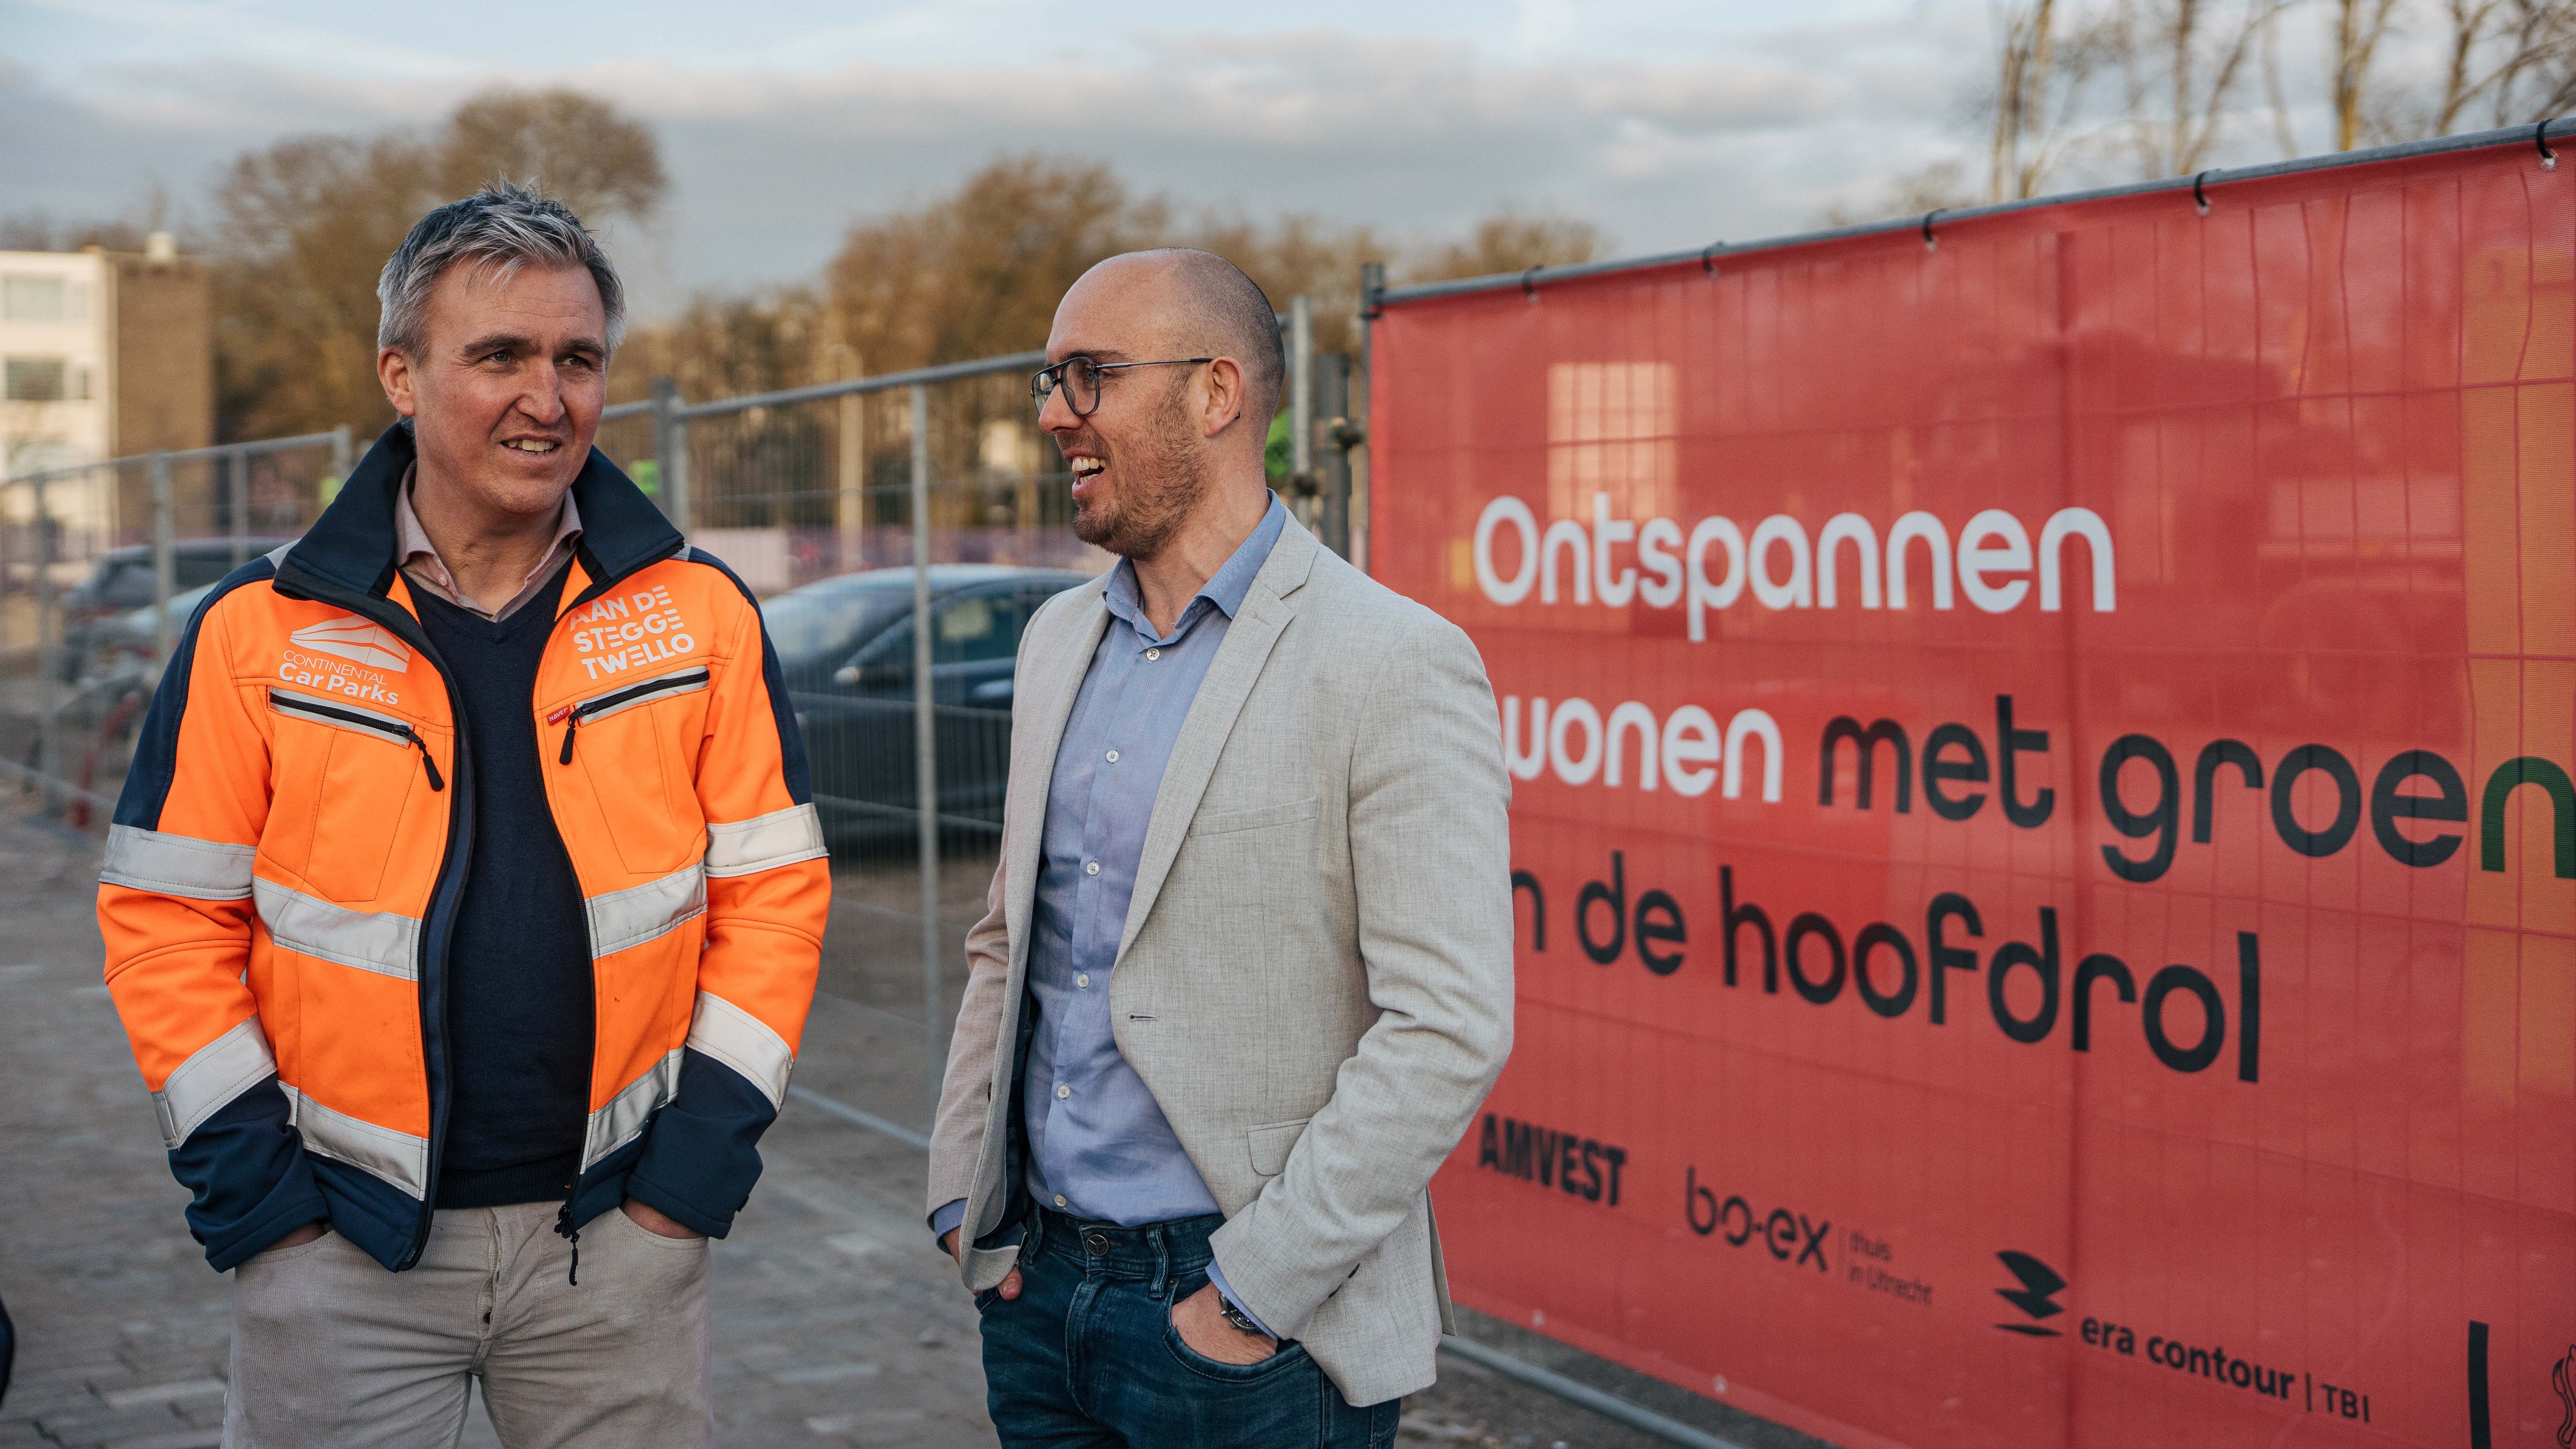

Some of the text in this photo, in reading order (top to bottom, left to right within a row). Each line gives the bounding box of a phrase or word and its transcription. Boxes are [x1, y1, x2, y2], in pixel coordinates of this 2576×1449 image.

[1473, 490, 2115, 642] Ontspannen
[570, 585, 672, 632] AAN DE
[573, 608, 684, 652] STEGGE
[283, 650, 388, 686] CONTINENTAL
[581, 633, 694, 680] TWELLO
[279, 662, 399, 705] Car Parks
[549, 707, 568, 722] HAVEP
[1818, 693, 2057, 829] met
[2098, 733, 2576, 881] groen
[1574, 849, 1688, 978] de
[1718, 864, 2261, 1085] hoofdrol
[1477, 1111, 1628, 1208] AMVEST
[2079, 1314, 2372, 1425] era contour TBI
